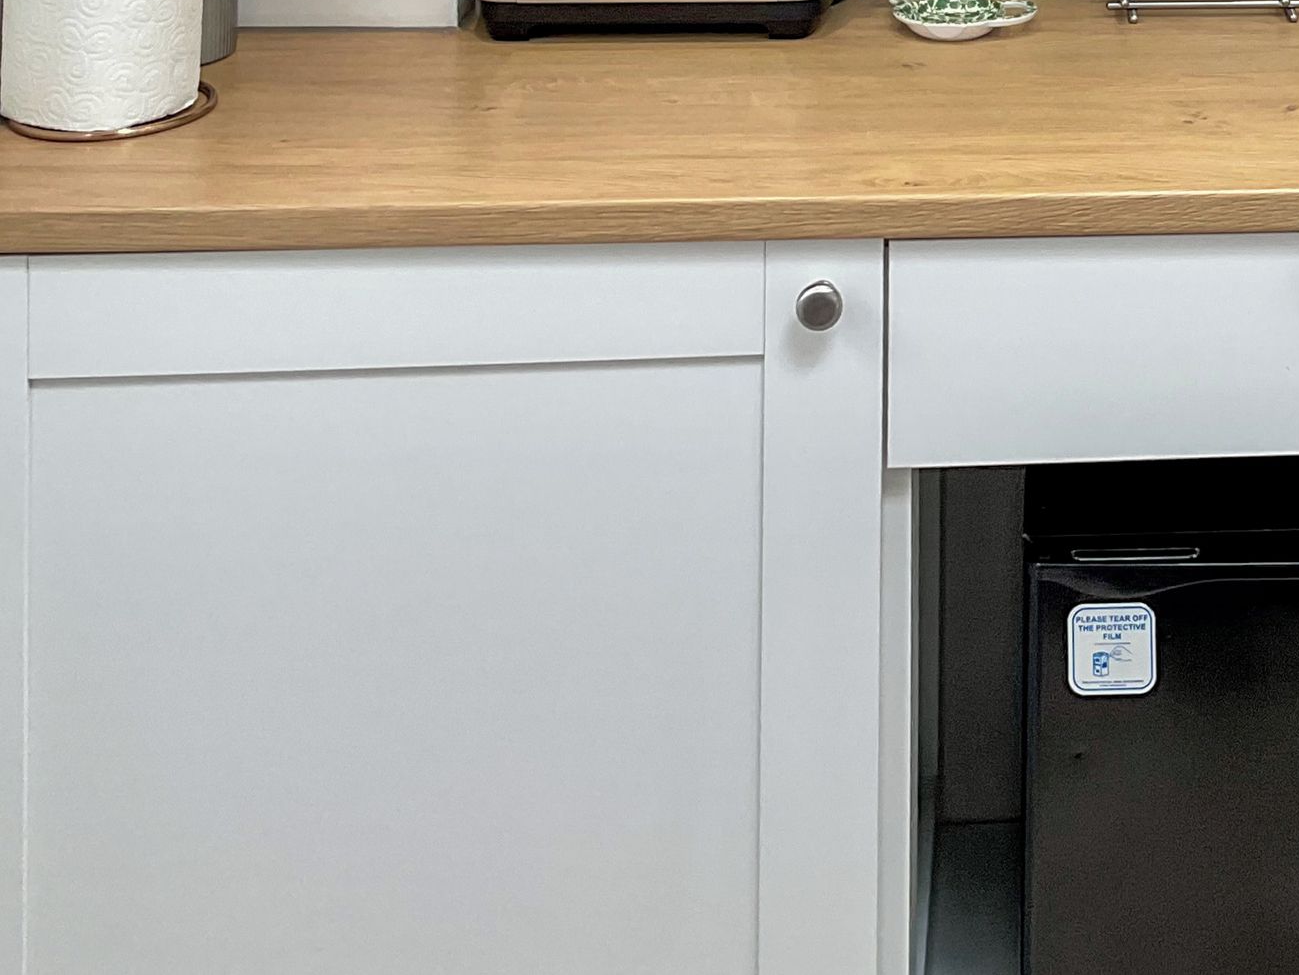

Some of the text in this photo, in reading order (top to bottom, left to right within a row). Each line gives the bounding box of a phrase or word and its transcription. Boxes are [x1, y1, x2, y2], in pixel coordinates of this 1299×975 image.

[1075, 614, 1148, 624] PLEASE TEAR OFF
[1078, 623, 1146, 632] THE PROTECTIVE
